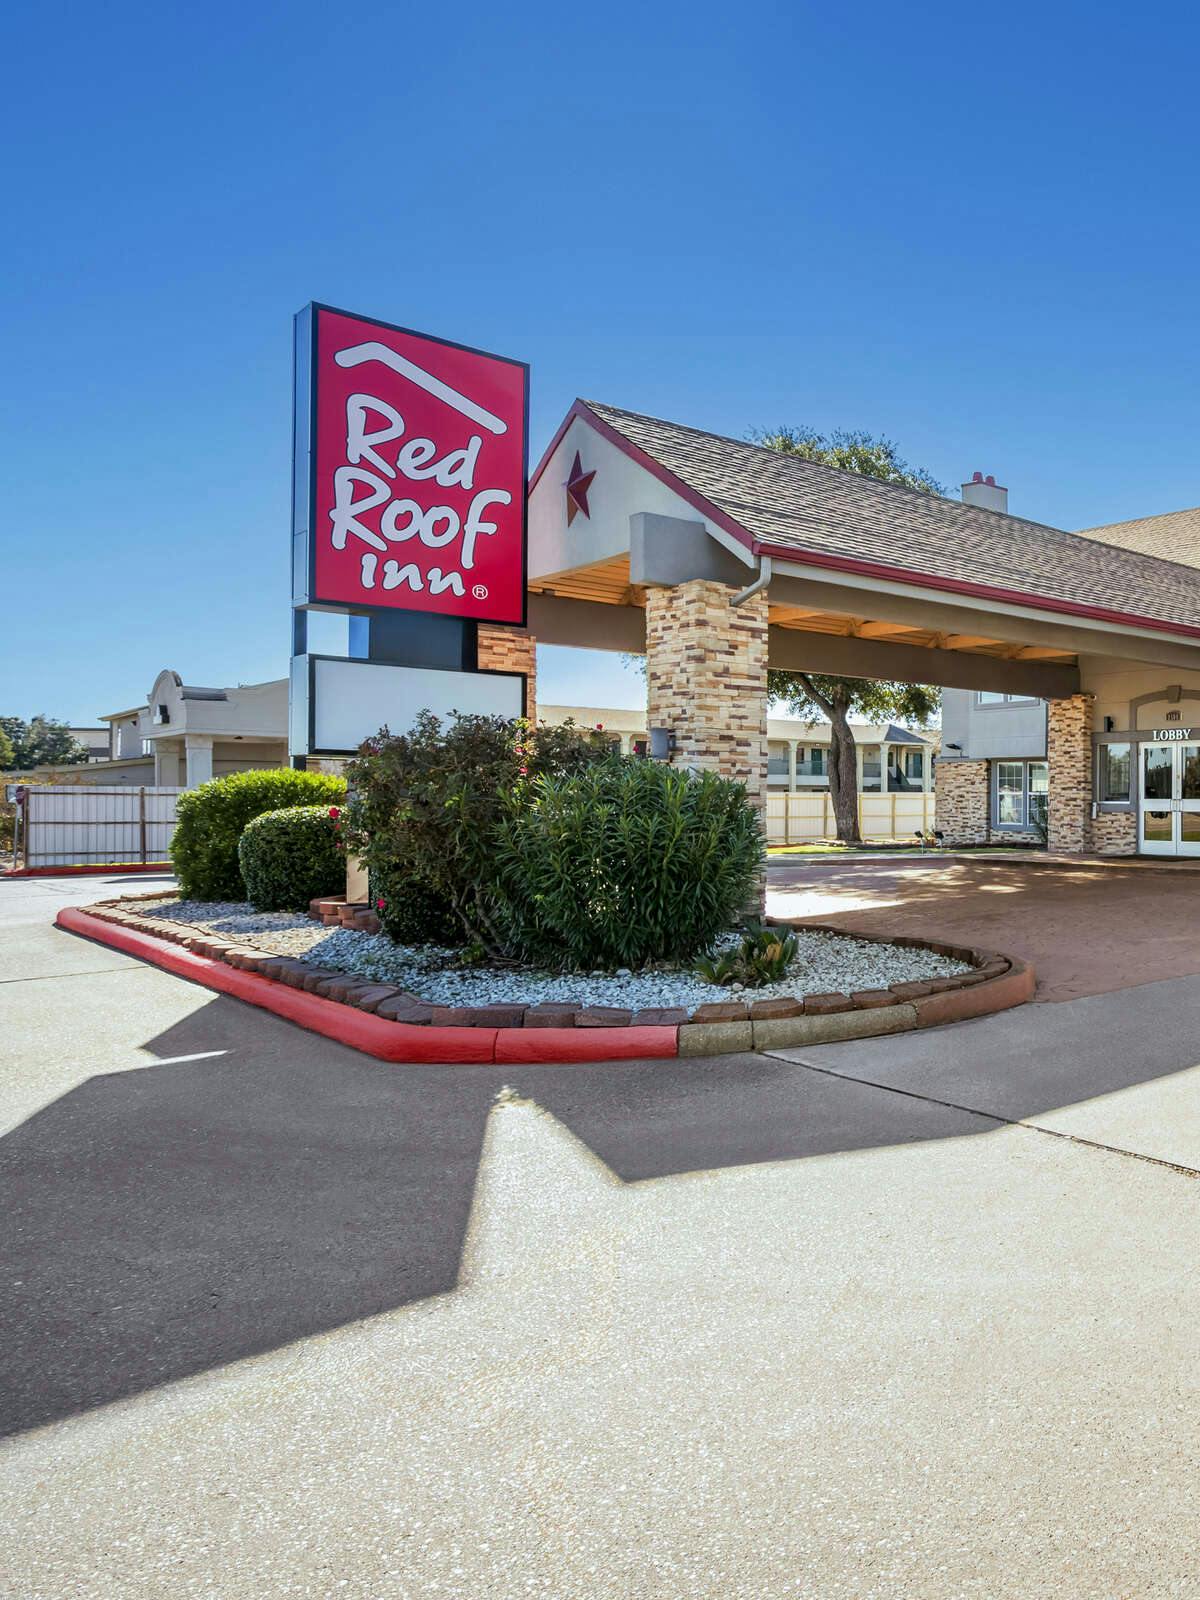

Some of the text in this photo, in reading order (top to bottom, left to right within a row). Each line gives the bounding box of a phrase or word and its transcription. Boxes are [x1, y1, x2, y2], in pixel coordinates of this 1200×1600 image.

[346, 393, 483, 490] Red
[329, 466, 512, 570] Roof
[1152, 728, 1191, 741] LOBBY
